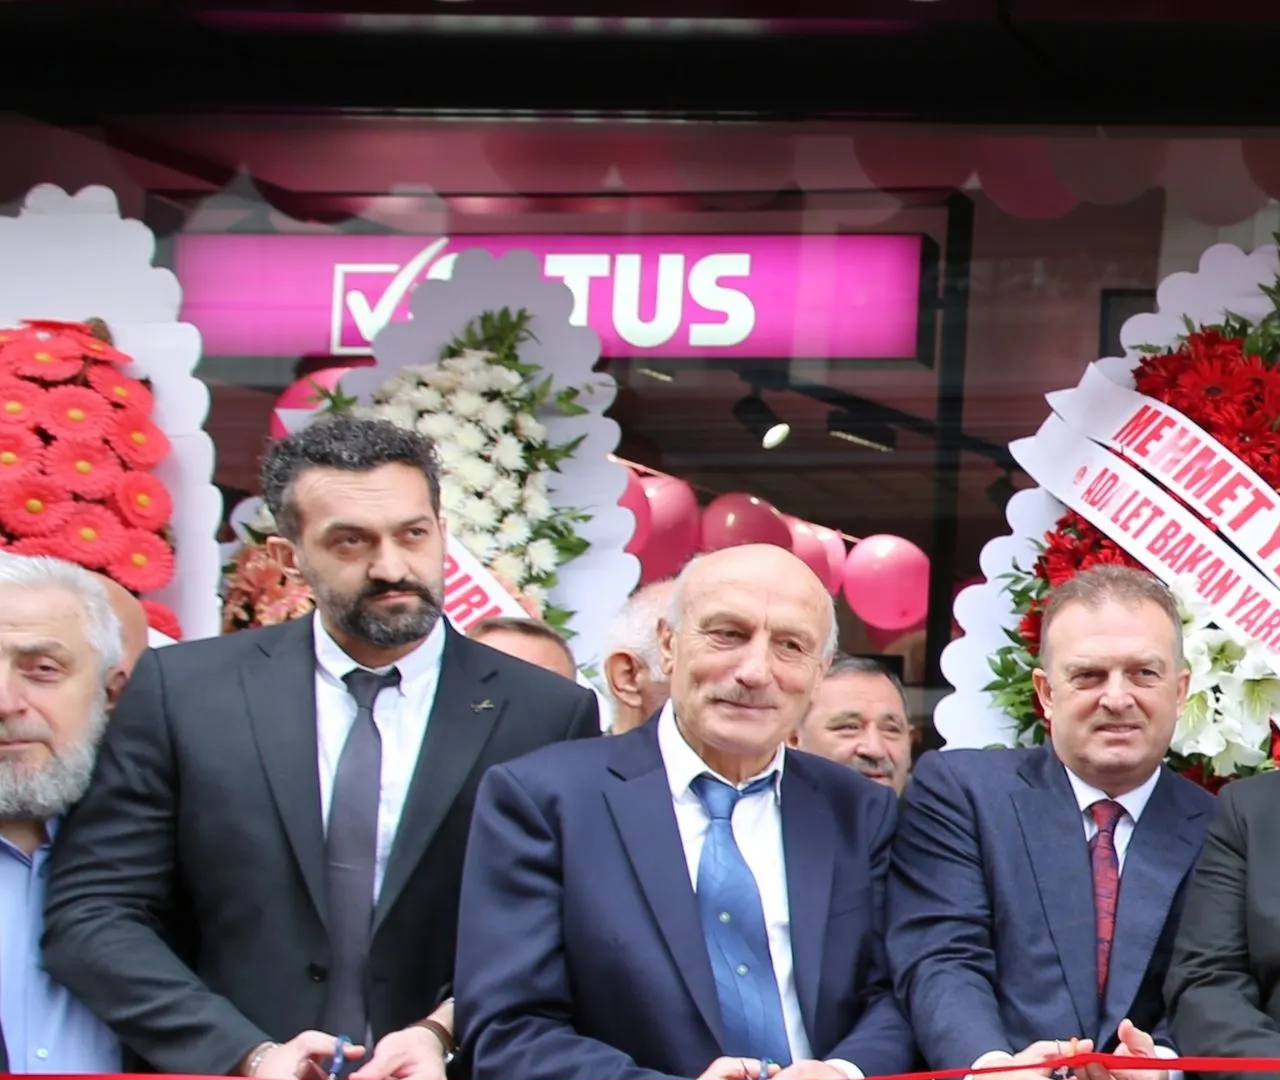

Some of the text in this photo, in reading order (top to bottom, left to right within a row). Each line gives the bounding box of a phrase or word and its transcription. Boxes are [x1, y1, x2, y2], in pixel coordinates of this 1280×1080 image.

[425, 252, 756, 348] TUS
[1112, 404, 1275, 532] MEHMET
[1145, 518, 1241, 605] BAKAN
